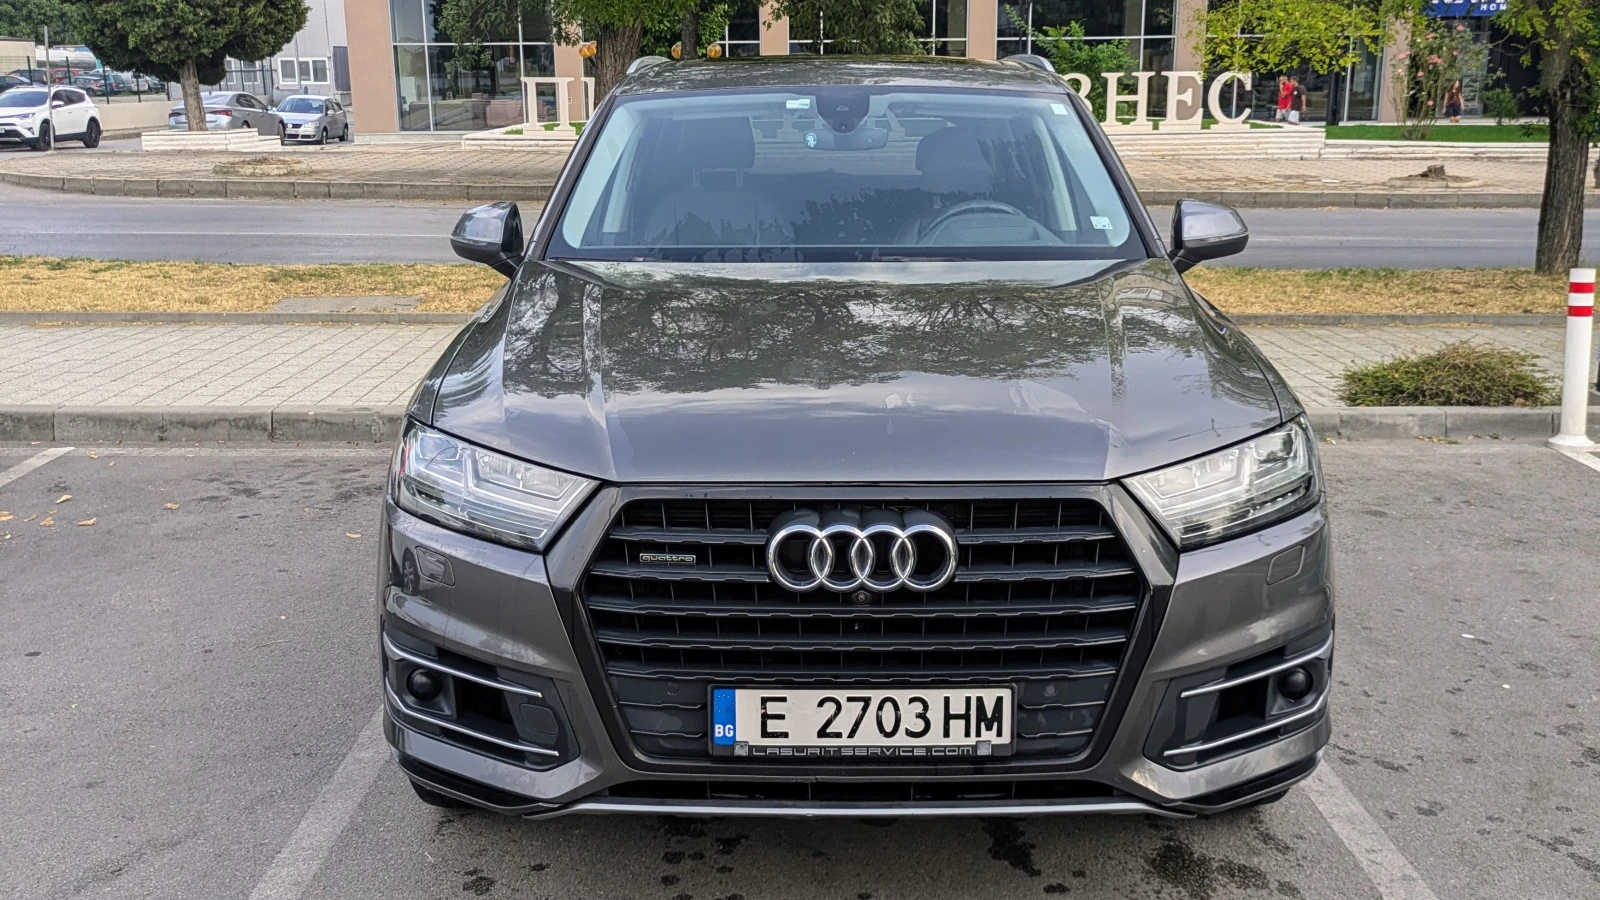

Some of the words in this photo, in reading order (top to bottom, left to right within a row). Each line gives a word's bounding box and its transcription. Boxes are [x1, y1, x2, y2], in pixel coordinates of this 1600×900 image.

[714, 724, 734, 738] BG
[760, 695, 789, 739] E
[816, 695, 932, 739] 2703
[943, 695, 1004, 739] HM
